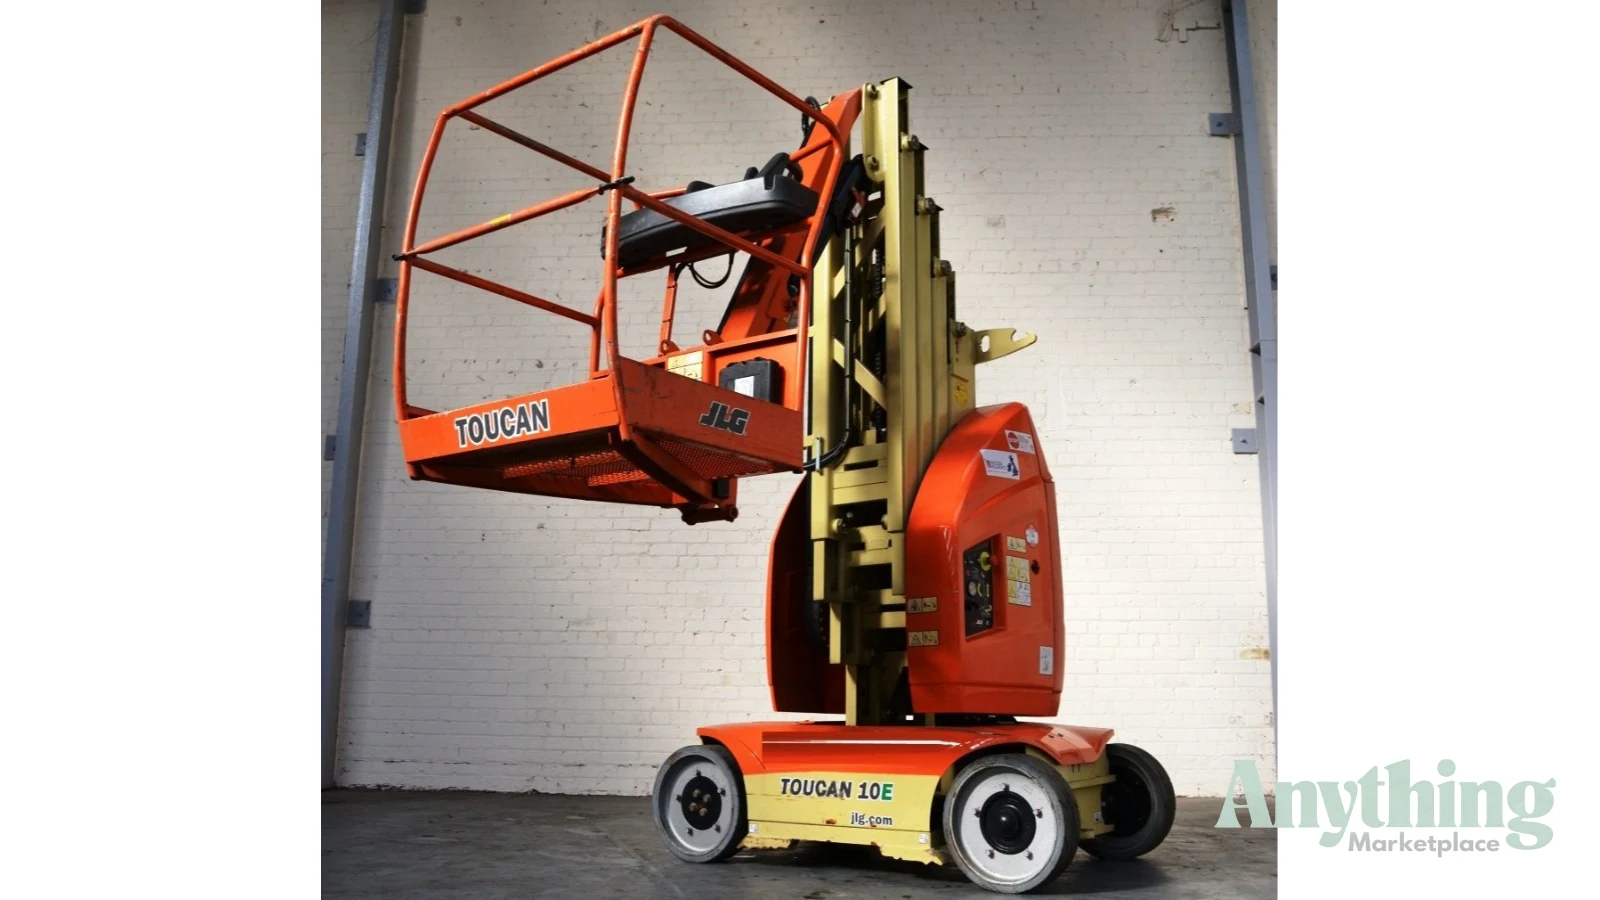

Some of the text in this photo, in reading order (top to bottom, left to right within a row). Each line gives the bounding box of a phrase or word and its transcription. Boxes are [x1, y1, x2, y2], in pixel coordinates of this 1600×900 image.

[455, 399, 549, 447] TOUCAN
[700, 401, 750, 435] JLG
[780, 778, 894, 801] TOUCAN 10E
[850, 812, 893, 827] jlg.com
